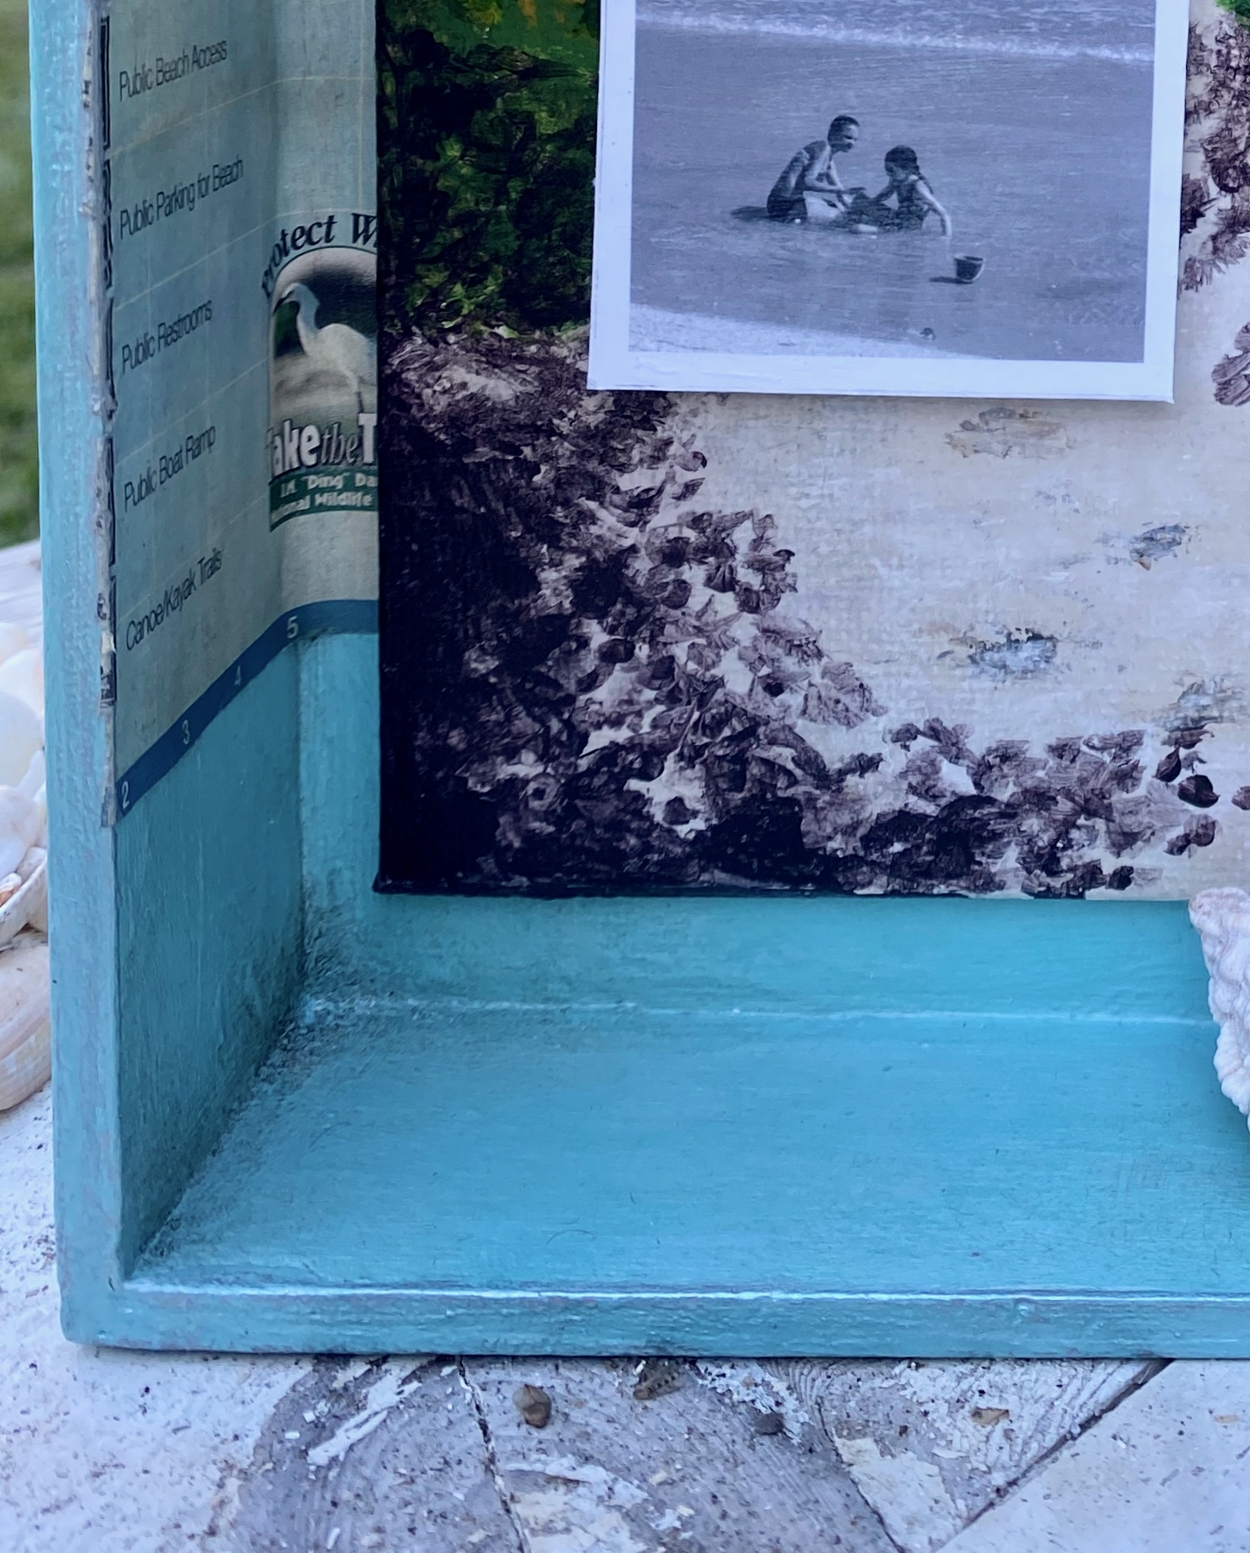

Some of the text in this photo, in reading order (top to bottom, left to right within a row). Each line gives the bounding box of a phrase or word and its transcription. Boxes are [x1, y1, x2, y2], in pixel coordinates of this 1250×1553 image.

[119, 64, 153, 102] Public
[156, 48, 189, 86] Beach
[191, 40, 228, 72] Access
[120, 154, 244, 240] Public Parking for Beach
[121, 299, 213, 375] Public Restrooms
[123, 425, 216, 513] Public Boat Ramp
[320, 421, 358, 465] the
[126, 569, 197, 650] Canoe/Kayak
[197, 547, 223, 586] Trails
[286, 615, 299, 639] 5
[234, 666, 242, 686] 4
[181, 720, 190, 744] 3
[121, 781, 130, 808] 2
